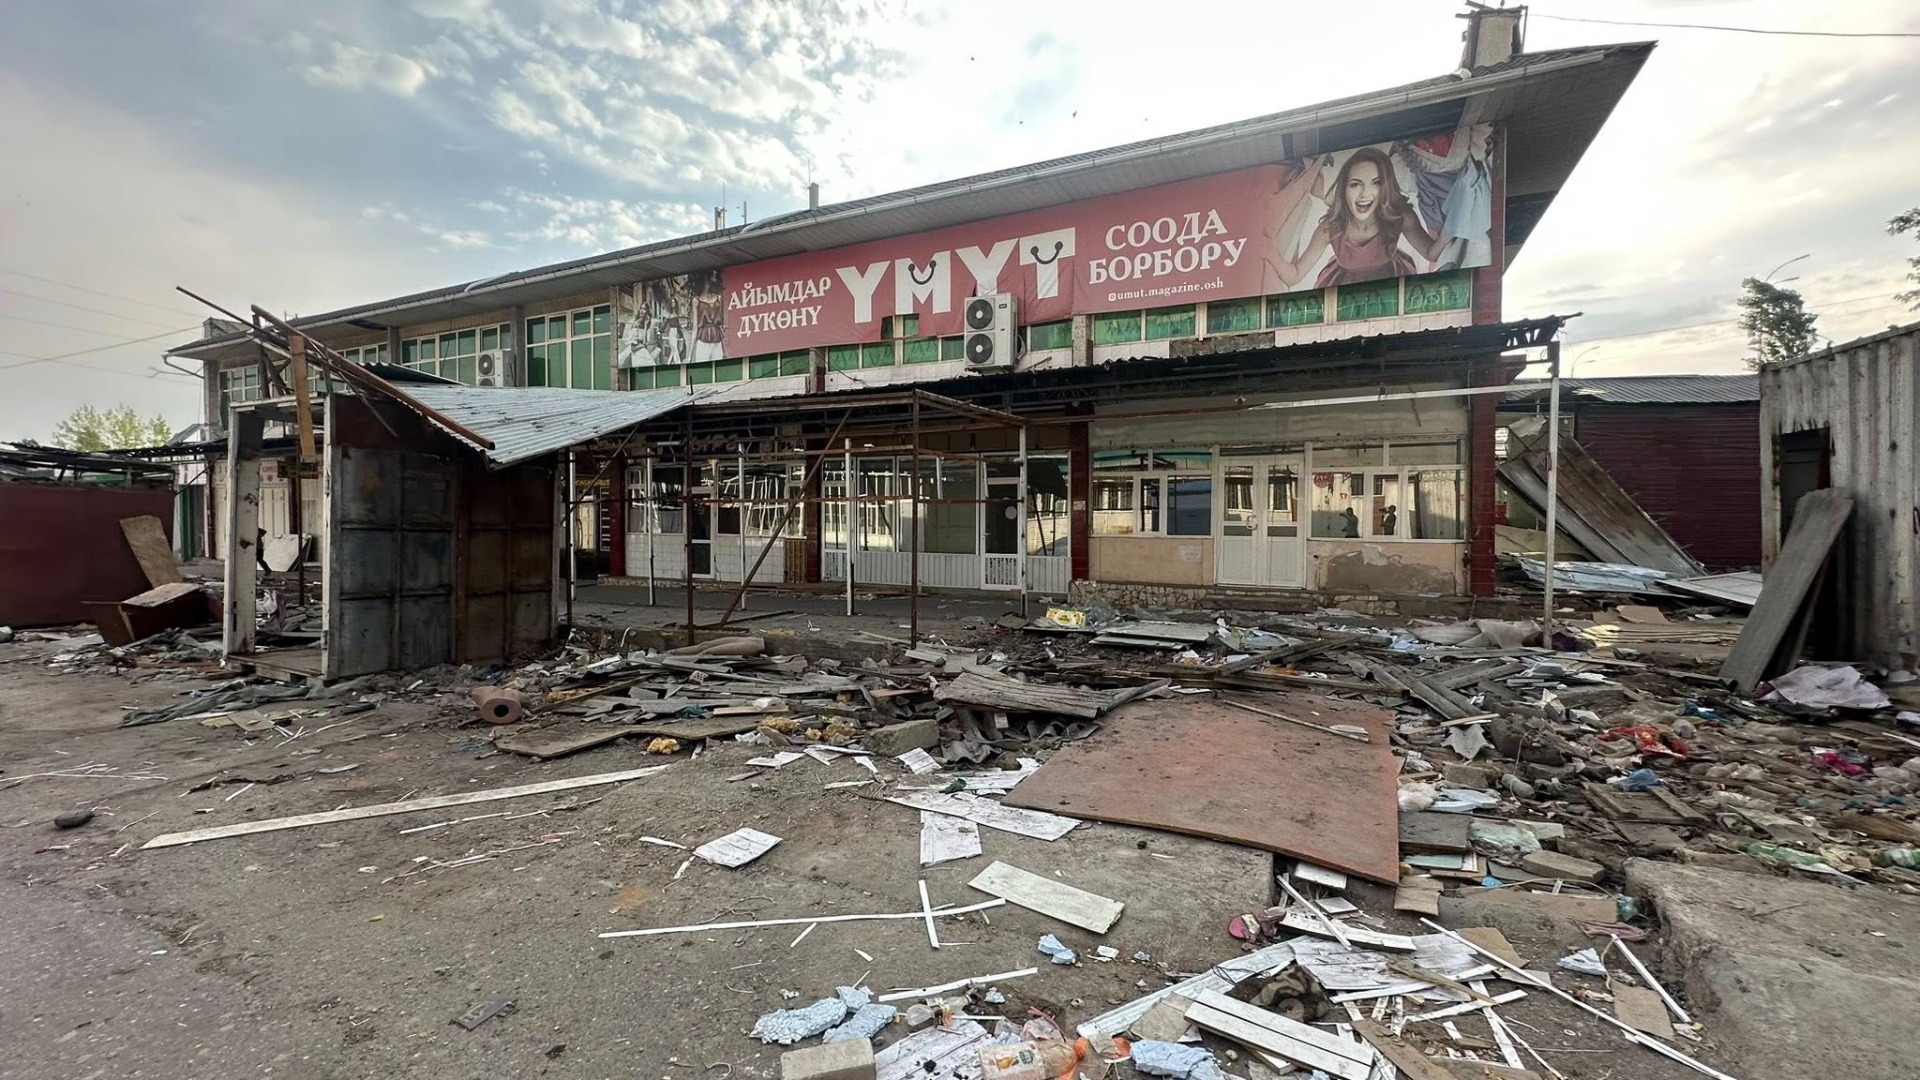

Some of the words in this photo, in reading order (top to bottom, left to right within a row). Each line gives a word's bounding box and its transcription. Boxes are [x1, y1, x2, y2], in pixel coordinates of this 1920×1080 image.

[1105, 208, 1228, 251] СООДА
[1088, 237, 1248, 285] БОРБОРУ
[727, 276, 832, 311] АЙЫМДАР
[736, 305, 822, 338] ДҮКӨНҮ
